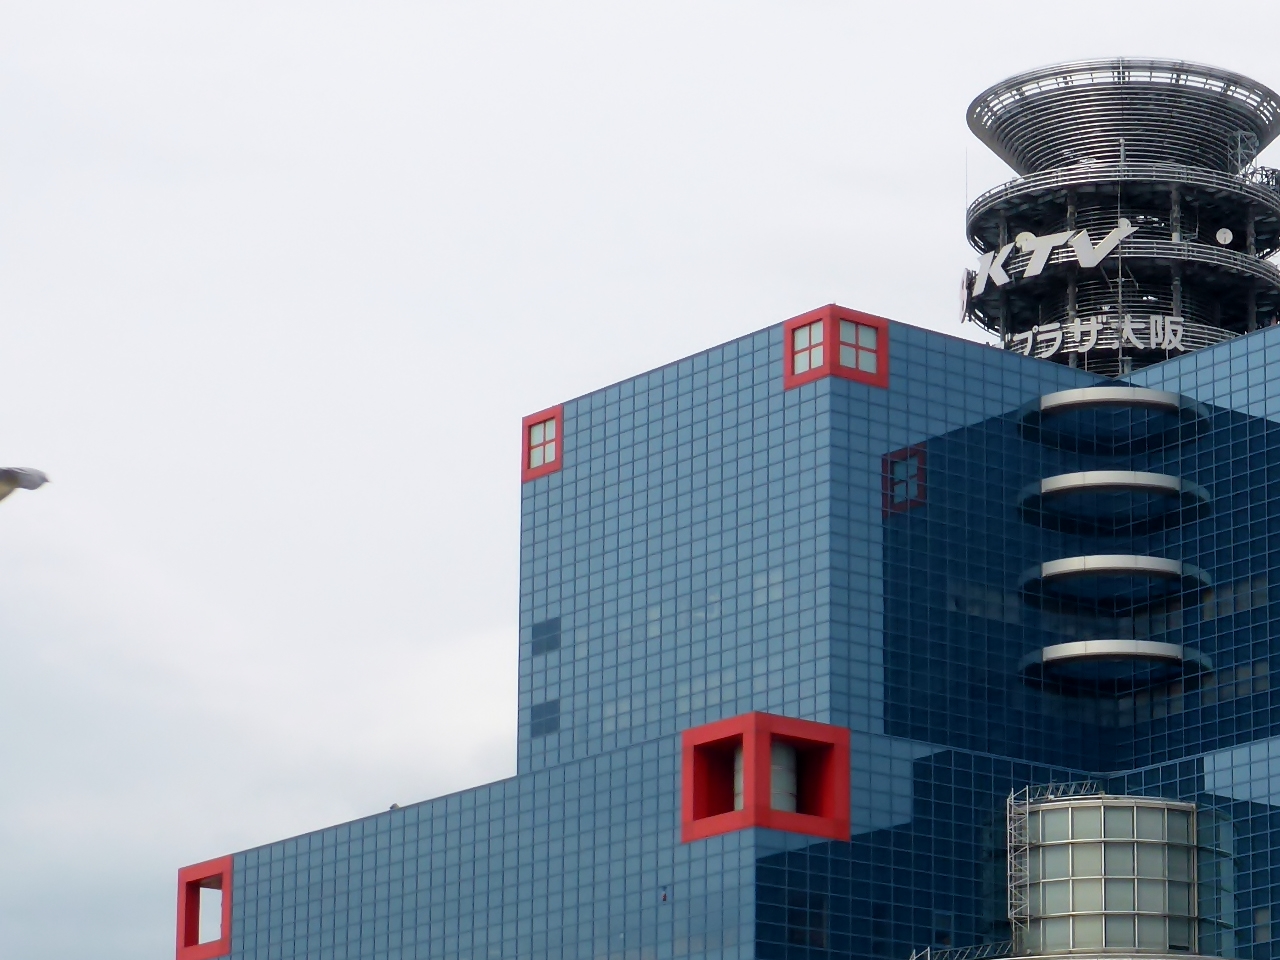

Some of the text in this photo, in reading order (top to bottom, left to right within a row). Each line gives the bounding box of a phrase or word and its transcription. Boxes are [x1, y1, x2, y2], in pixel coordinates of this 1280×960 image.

[972, 226, 1139, 297] KTV
[1005, 314, 1185, 358] プラザ大阪
